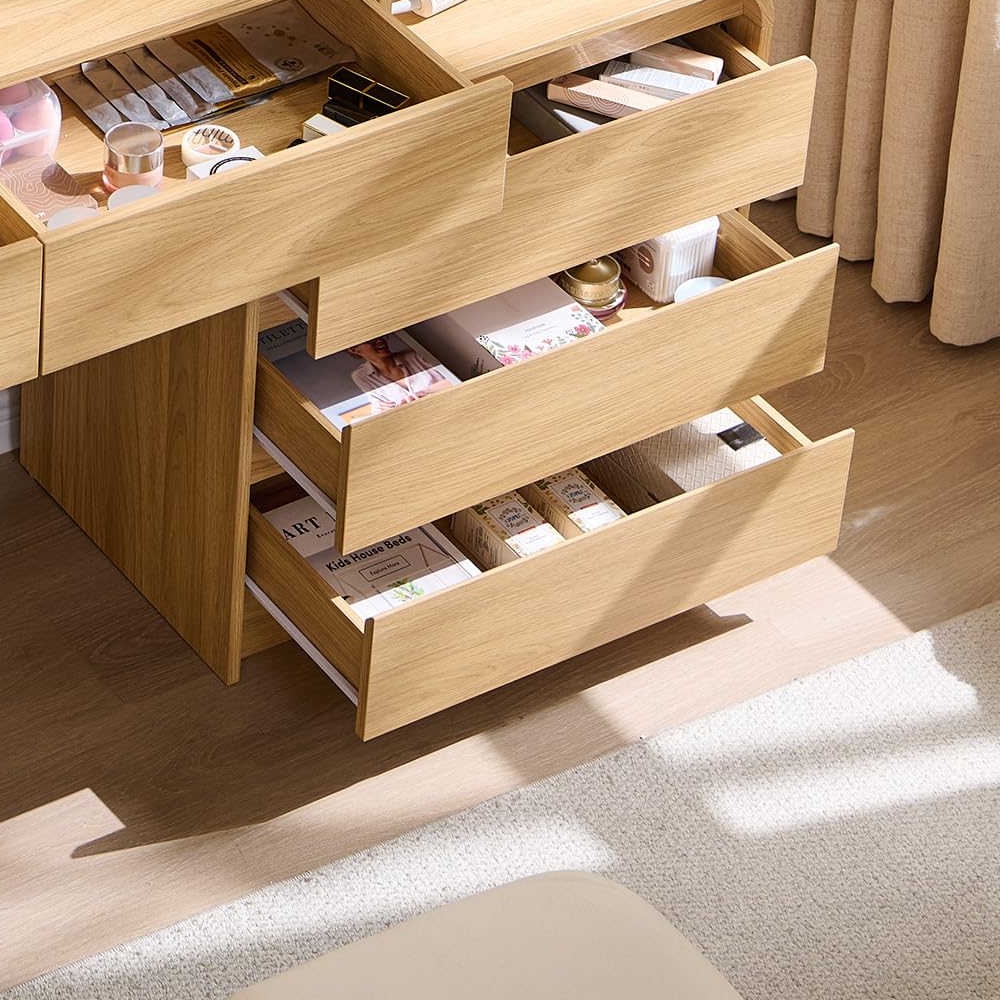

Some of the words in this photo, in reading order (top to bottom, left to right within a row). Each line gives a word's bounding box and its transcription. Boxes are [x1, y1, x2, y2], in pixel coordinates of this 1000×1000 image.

[281, 516, 321, 541] ART
[325, 556, 352, 573] Kids
[350, 544, 385, 563] House
[383, 534, 413, 550] Beds
